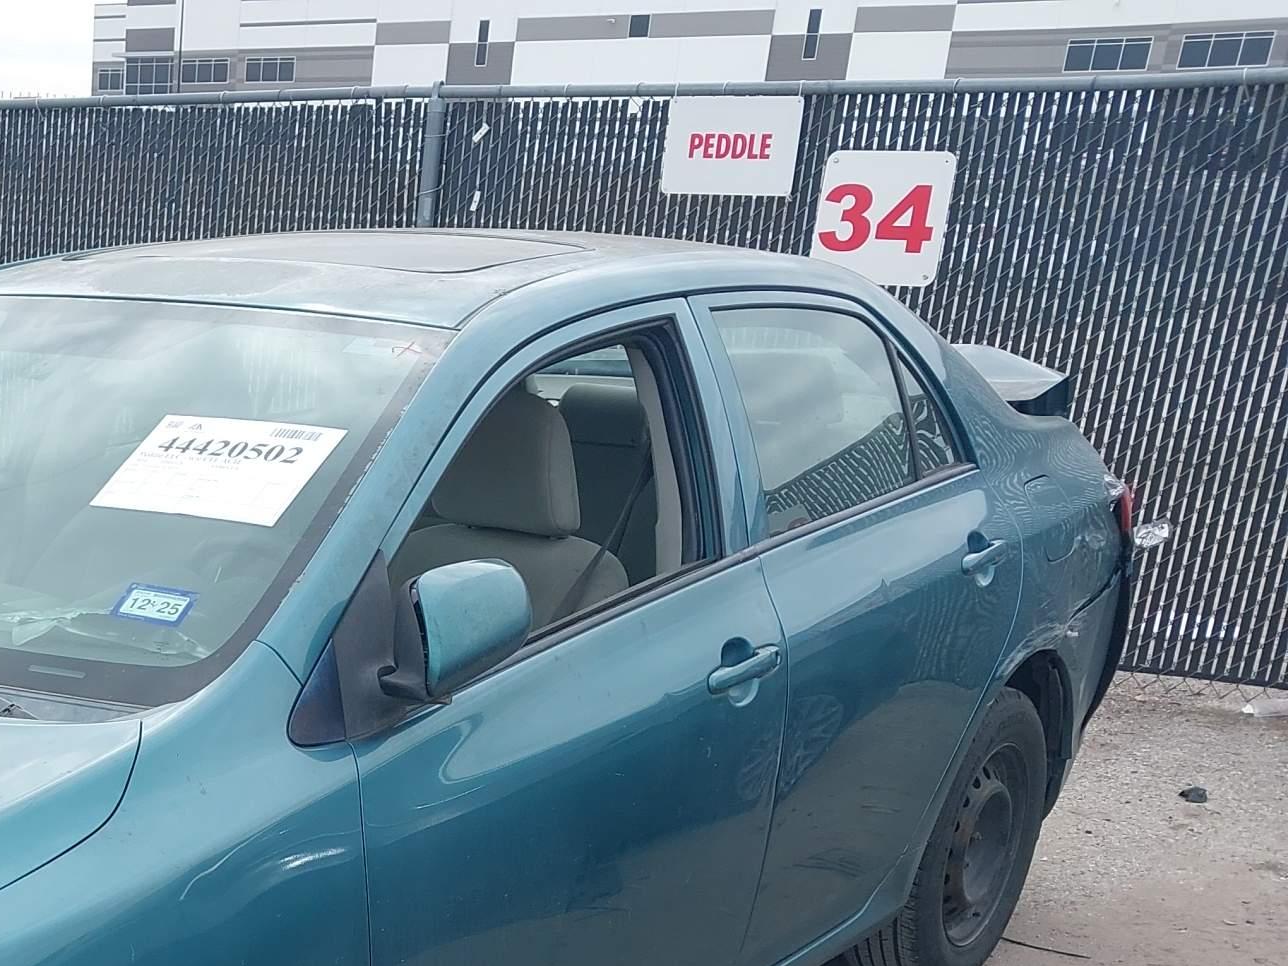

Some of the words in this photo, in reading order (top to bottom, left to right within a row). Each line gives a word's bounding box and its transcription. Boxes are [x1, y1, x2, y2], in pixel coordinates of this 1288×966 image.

[688, 133, 773, 160] PEDDLE
[818, 183, 934, 254] 34
[157, 436, 304, 465] 44420502
